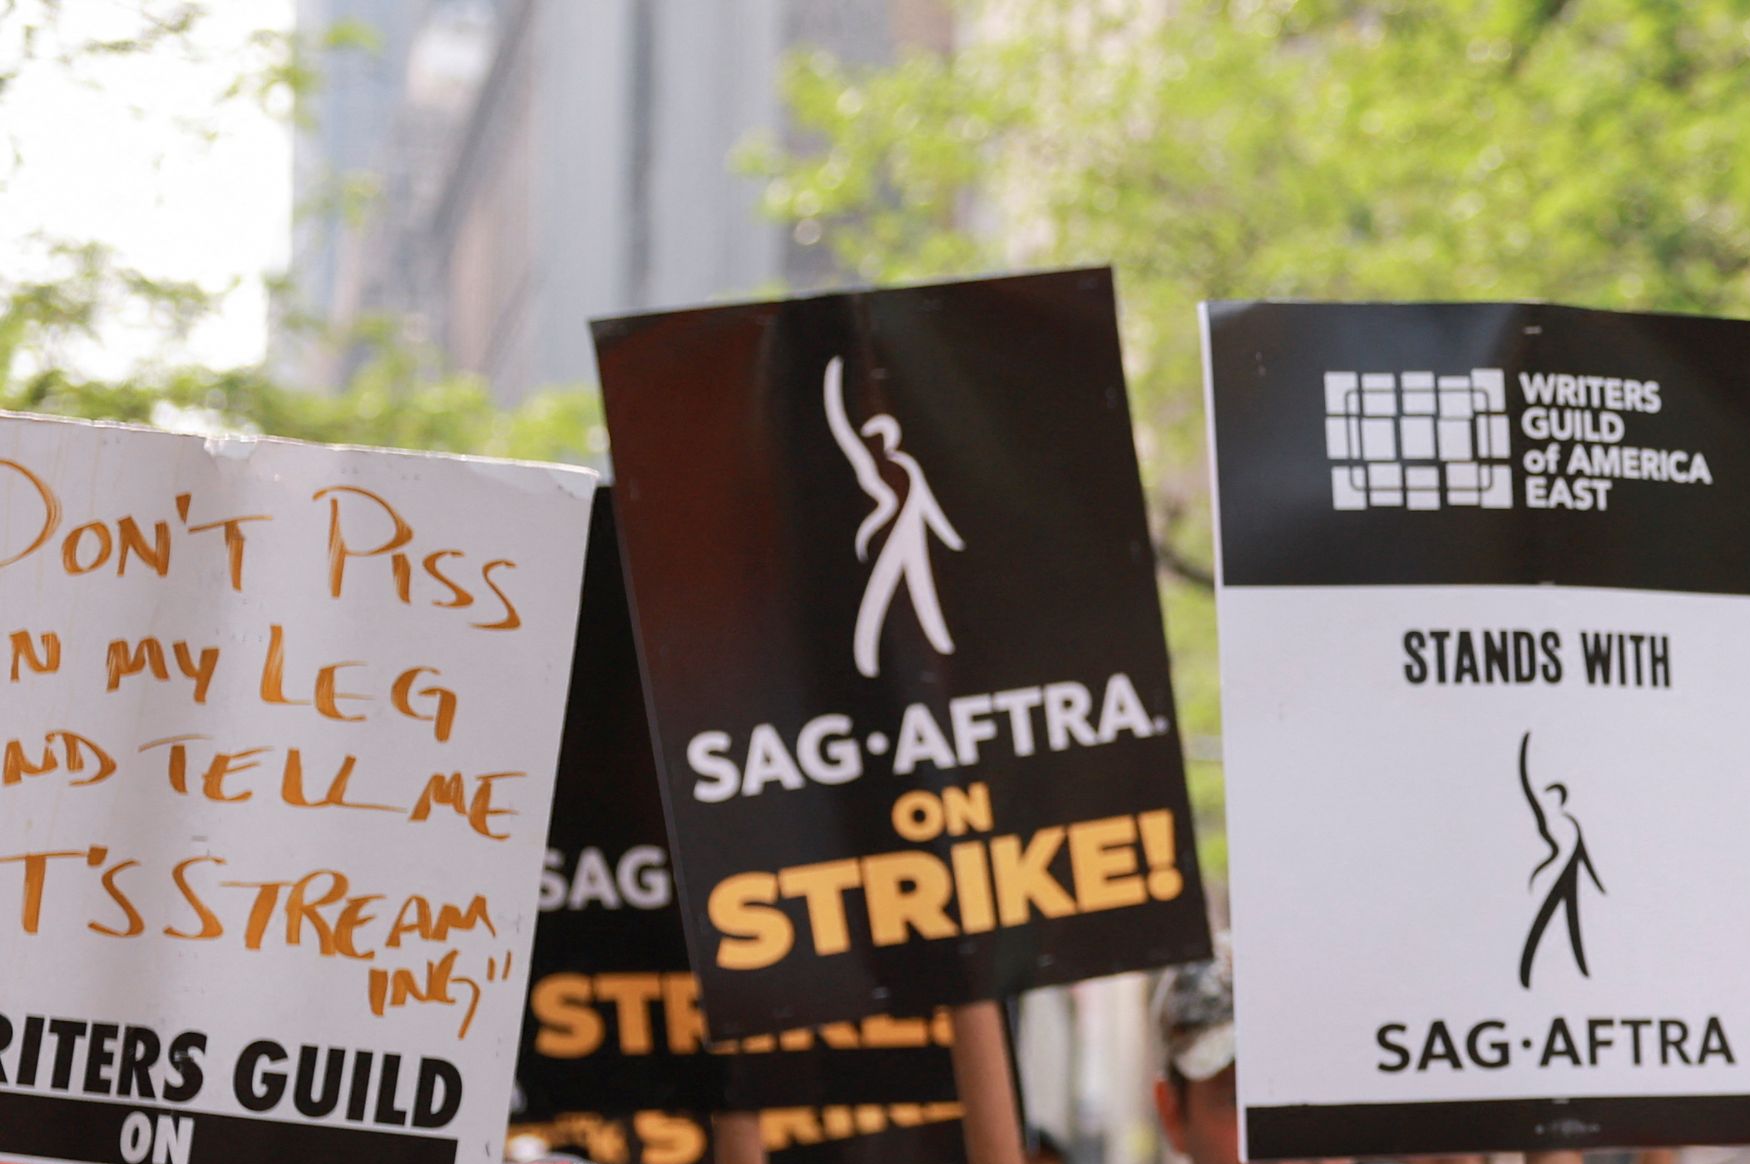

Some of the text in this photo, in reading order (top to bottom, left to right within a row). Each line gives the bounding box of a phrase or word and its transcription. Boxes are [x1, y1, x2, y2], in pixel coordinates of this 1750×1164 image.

[1520, 372, 1661, 414] WRITERS
[1521, 408, 1625, 444] GUILD
[1523, 445, 1712, 486] of AMERICA
[1525, 478, 1612, 512] EAST
[10, 624, 457, 742] N MY LEG
[1403, 629, 1671, 689] STANDS WITH
[2, 731, 527, 840] ND TELL ME
[891, 783, 992, 841] ON
[0, 846, 144, 938] T'S
[536, 845, 672, 910] SAG
[708, 808, 1184, 970] STRIKE!
[232, 1039, 463, 1129] GUILD
